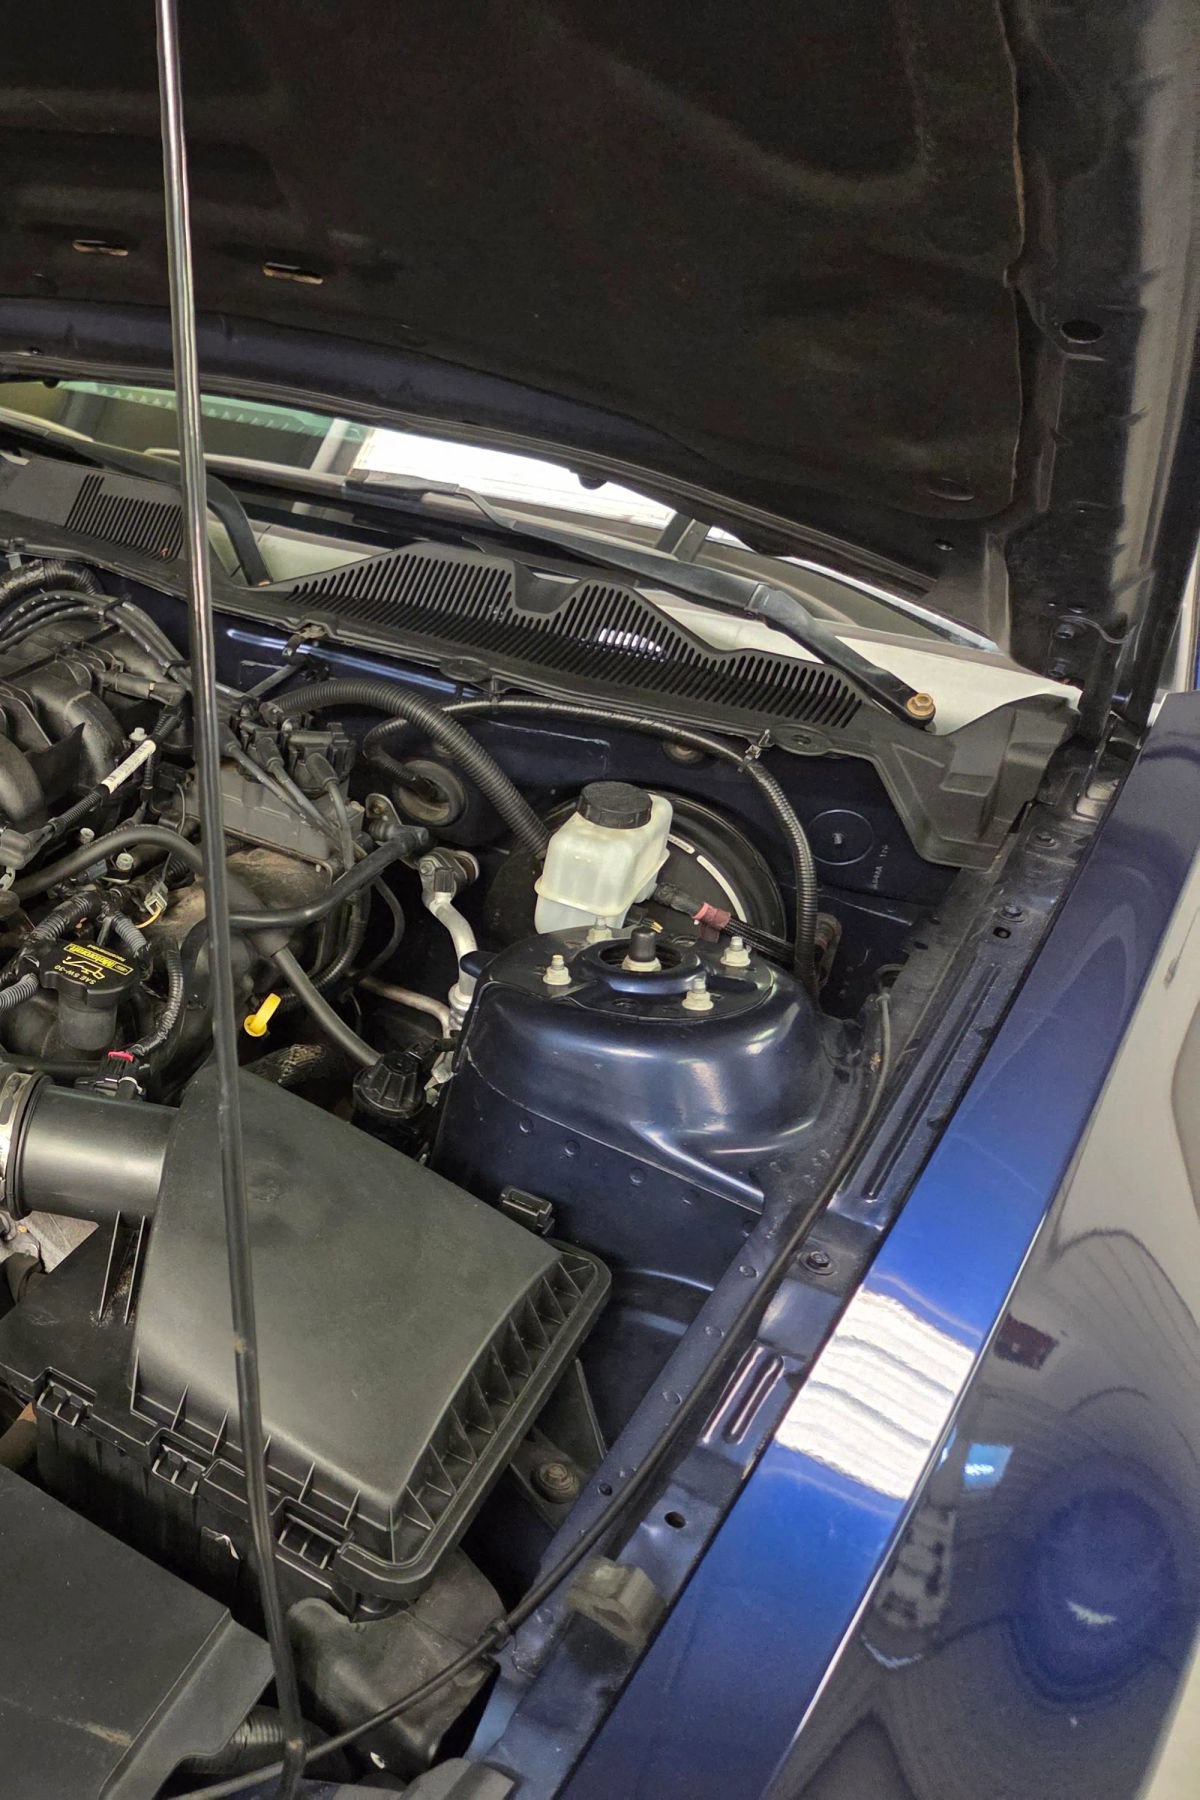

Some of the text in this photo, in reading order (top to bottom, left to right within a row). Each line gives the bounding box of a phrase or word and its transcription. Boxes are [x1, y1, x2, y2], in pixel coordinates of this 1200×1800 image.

[68, 943, 115, 969] Motorcraft
[54, 964, 97, 985] SAE 5W-30
